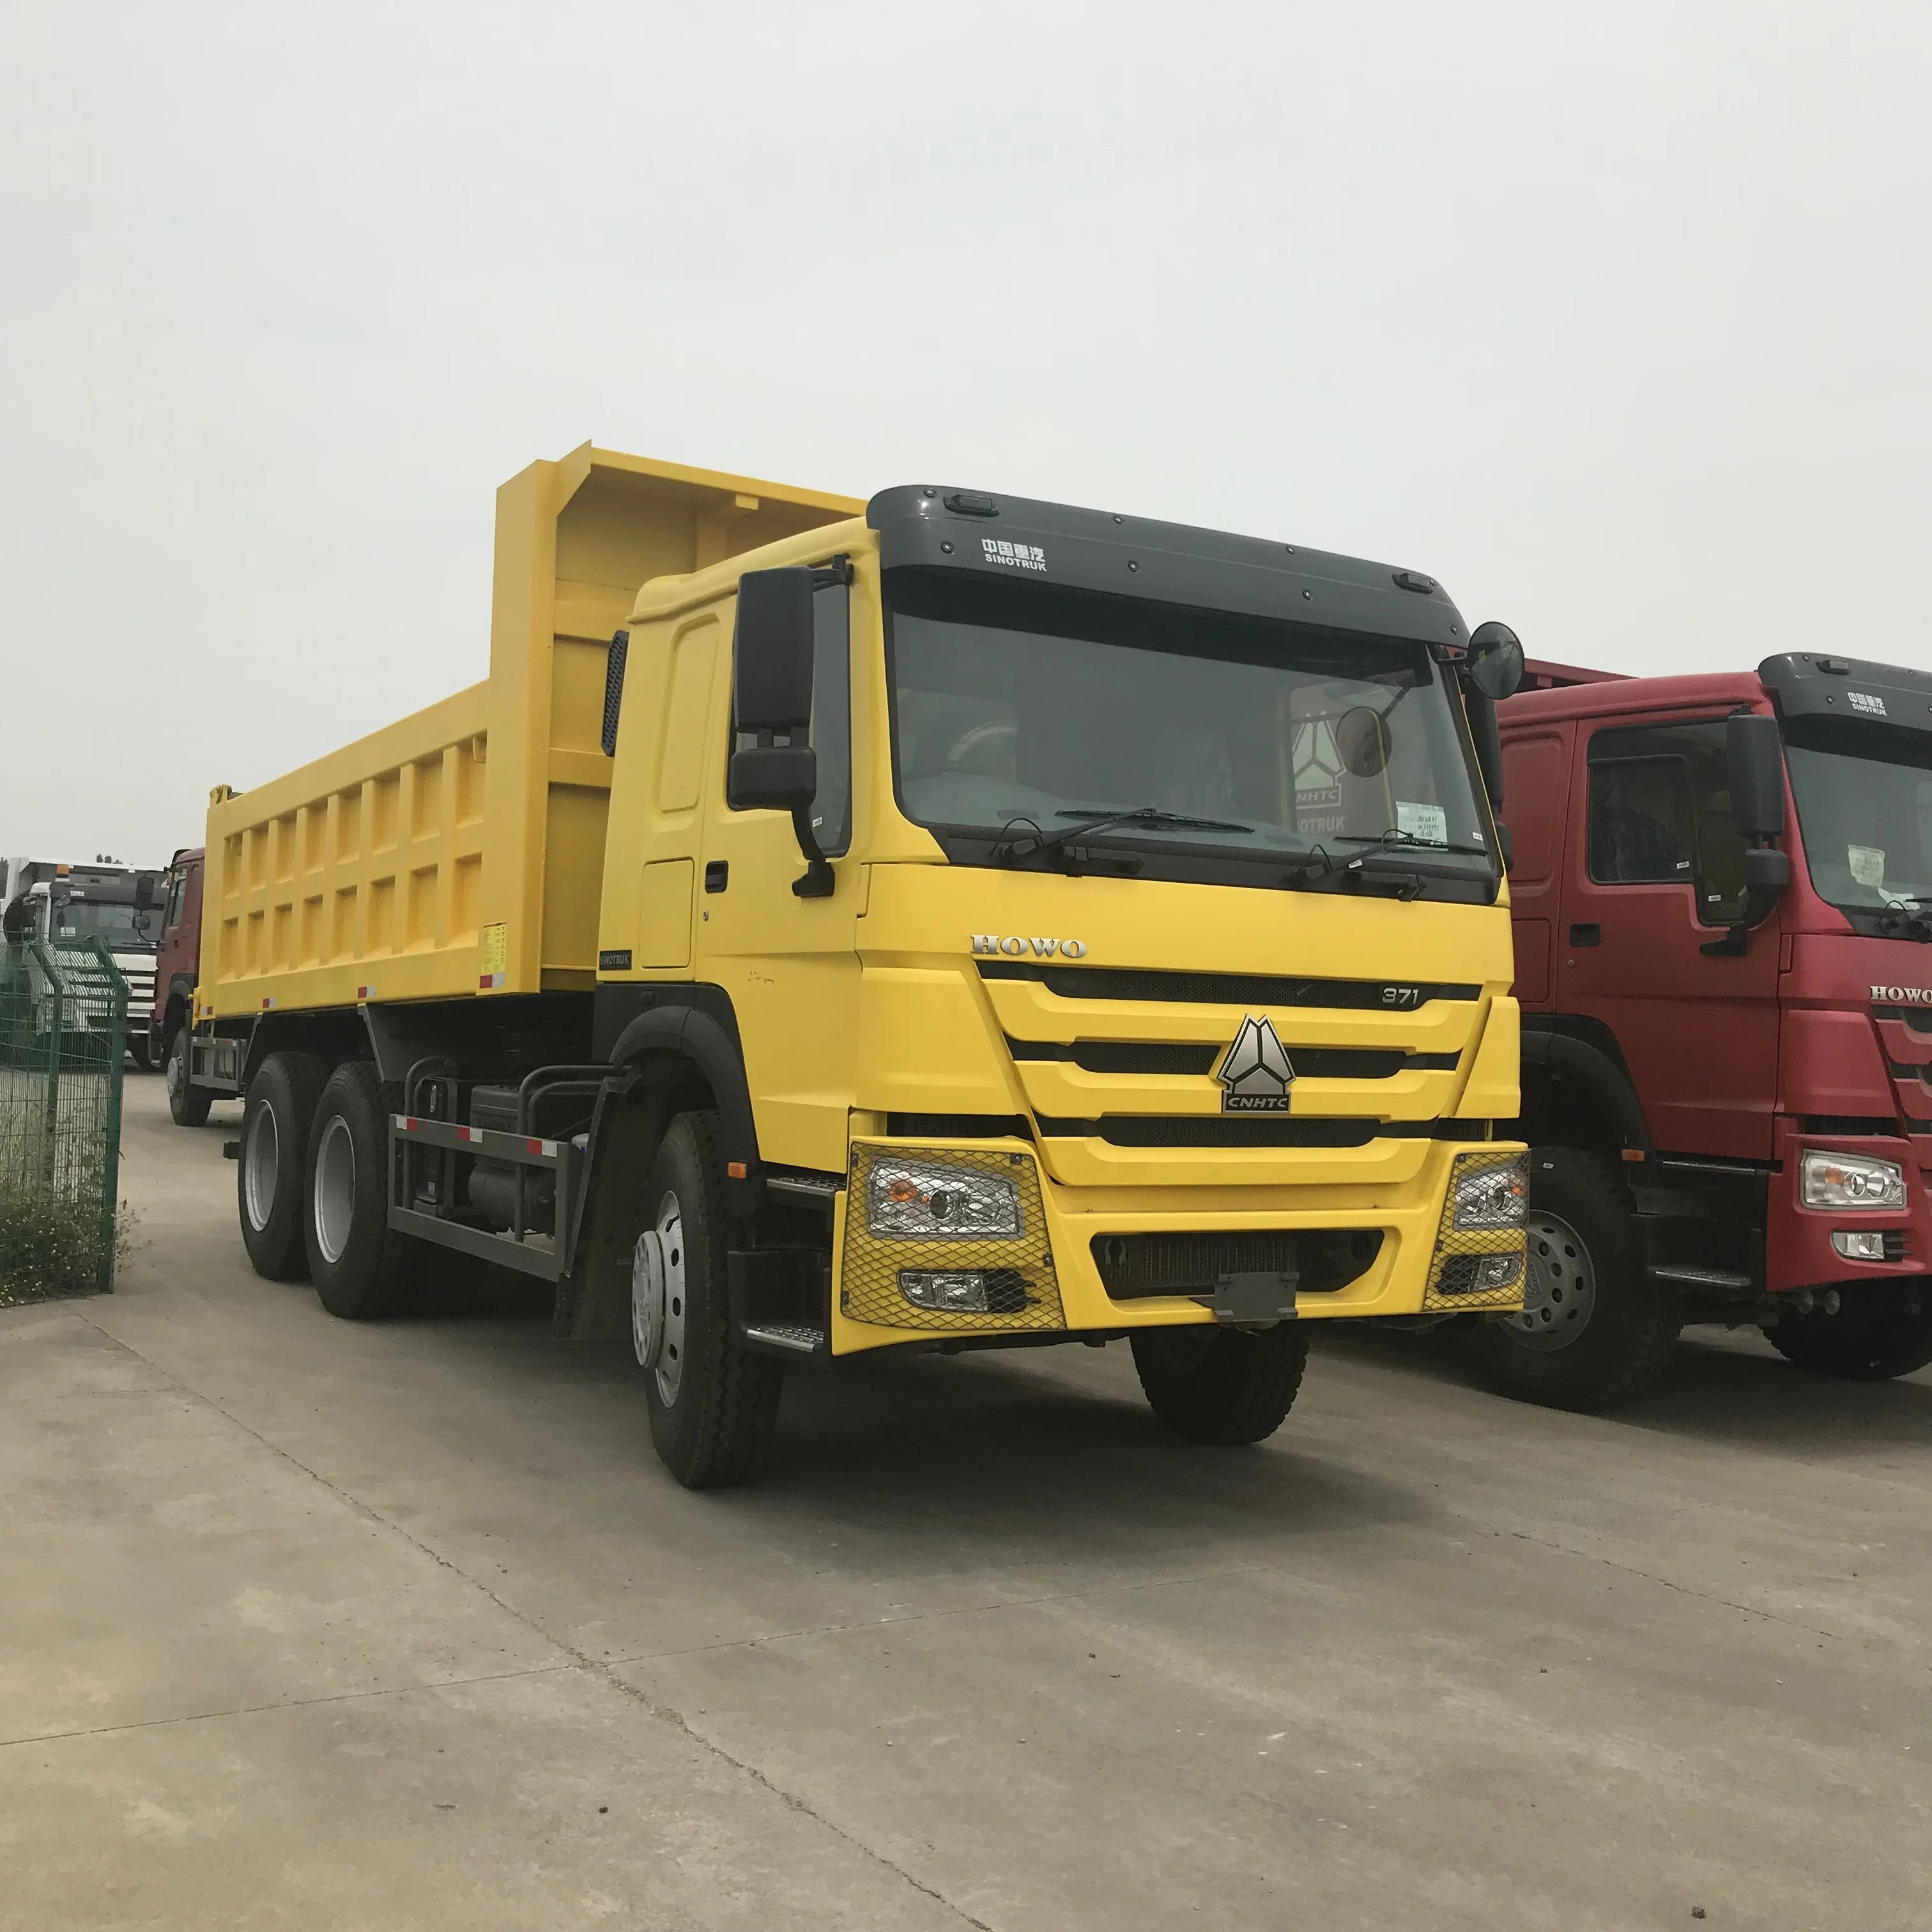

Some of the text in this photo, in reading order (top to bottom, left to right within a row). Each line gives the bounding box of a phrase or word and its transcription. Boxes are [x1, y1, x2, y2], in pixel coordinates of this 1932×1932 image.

[981, 539, 1045, 562] 中国重汽
[985, 553, 1047, 572] SINOTRUK
[1296, 790, 1338, 802] NHTC
[1297, 816, 1346, 833] OTRUK
[970, 935, 1087, 958] HOWO
[600, 954, 629, 965] SINOTRUK
[1382, 988, 1418, 1005] 371
[1869, 985, 1932, 1004] HOWO
[1228, 1097, 1288, 1108] CNHTC
